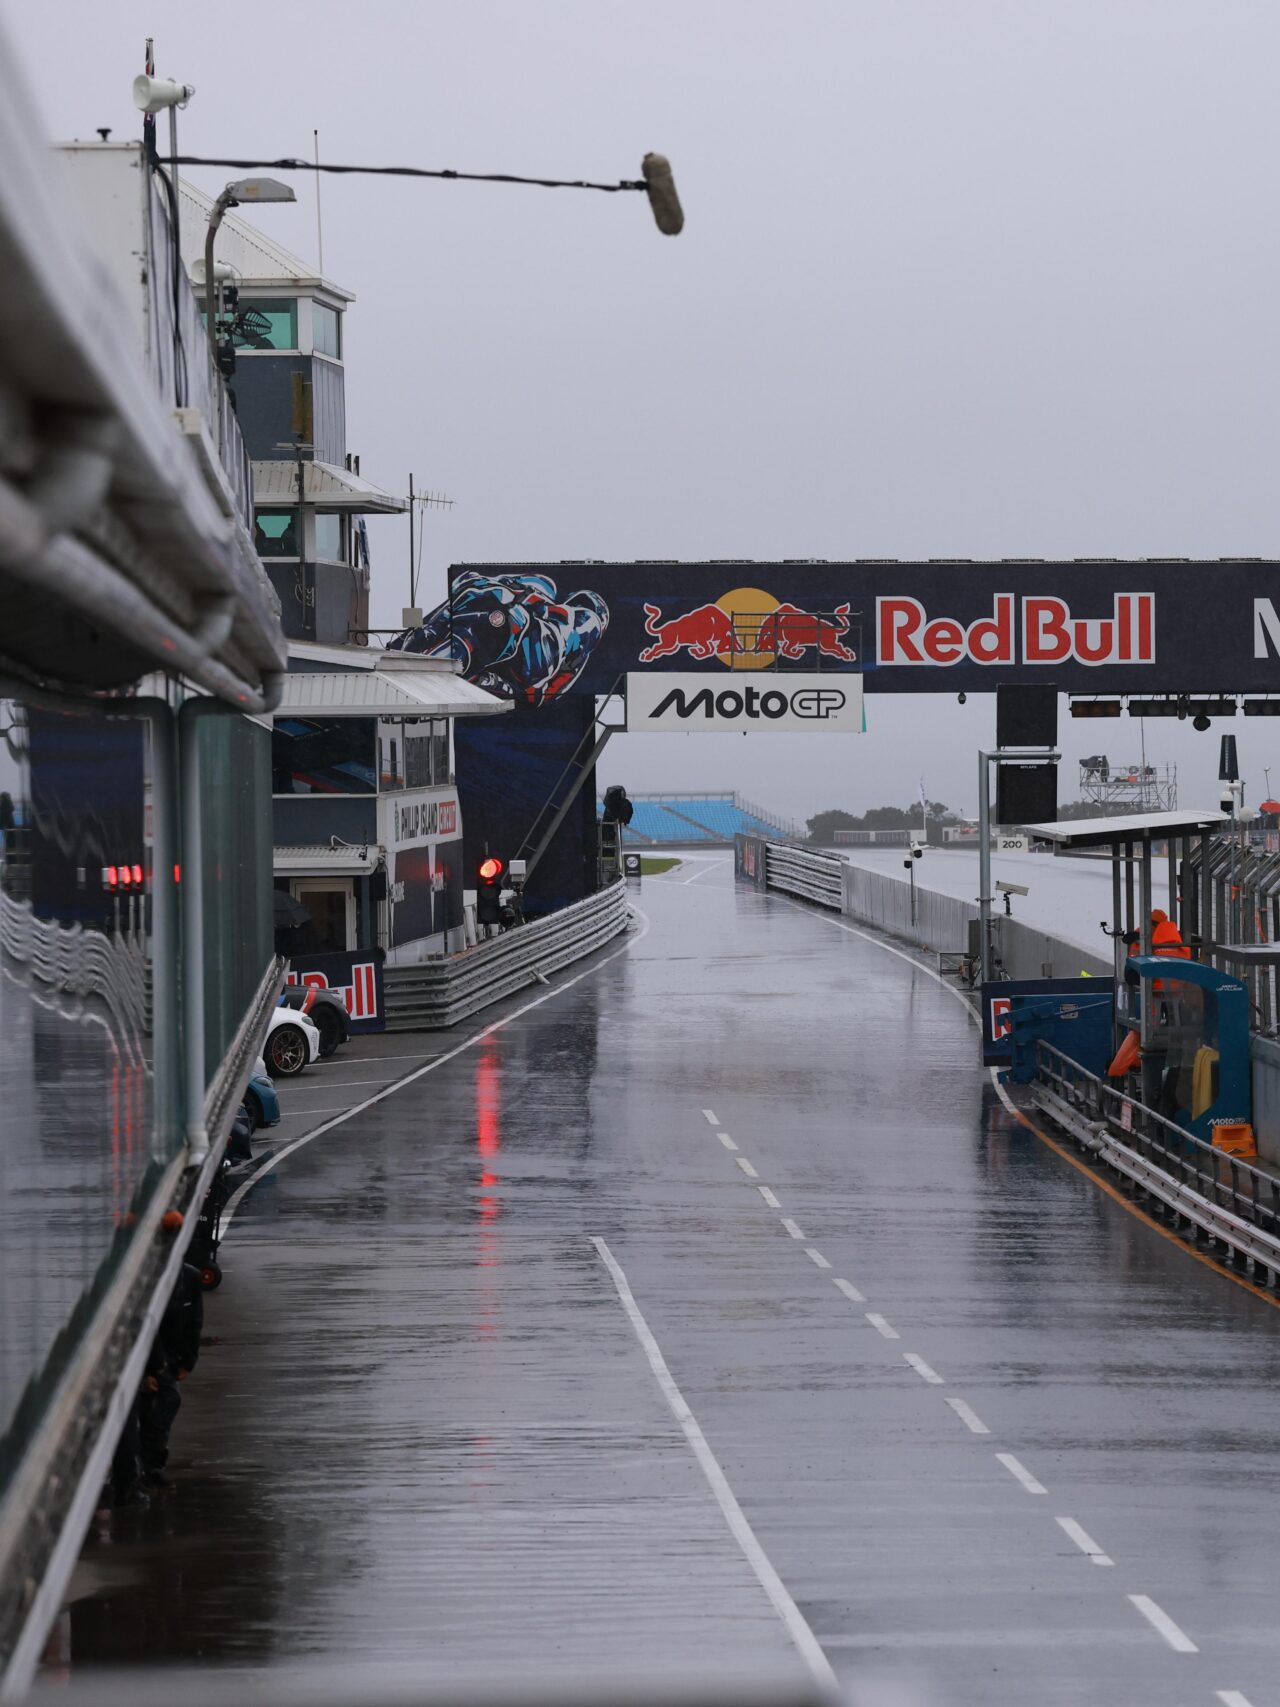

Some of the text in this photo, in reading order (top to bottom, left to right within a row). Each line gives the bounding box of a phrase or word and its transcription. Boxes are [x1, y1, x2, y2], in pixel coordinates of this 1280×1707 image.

[876, 592, 1156, 666] Red Bull
[648, 686, 846, 719] MotoGP
[1003, 840, 1023, 849] 200
